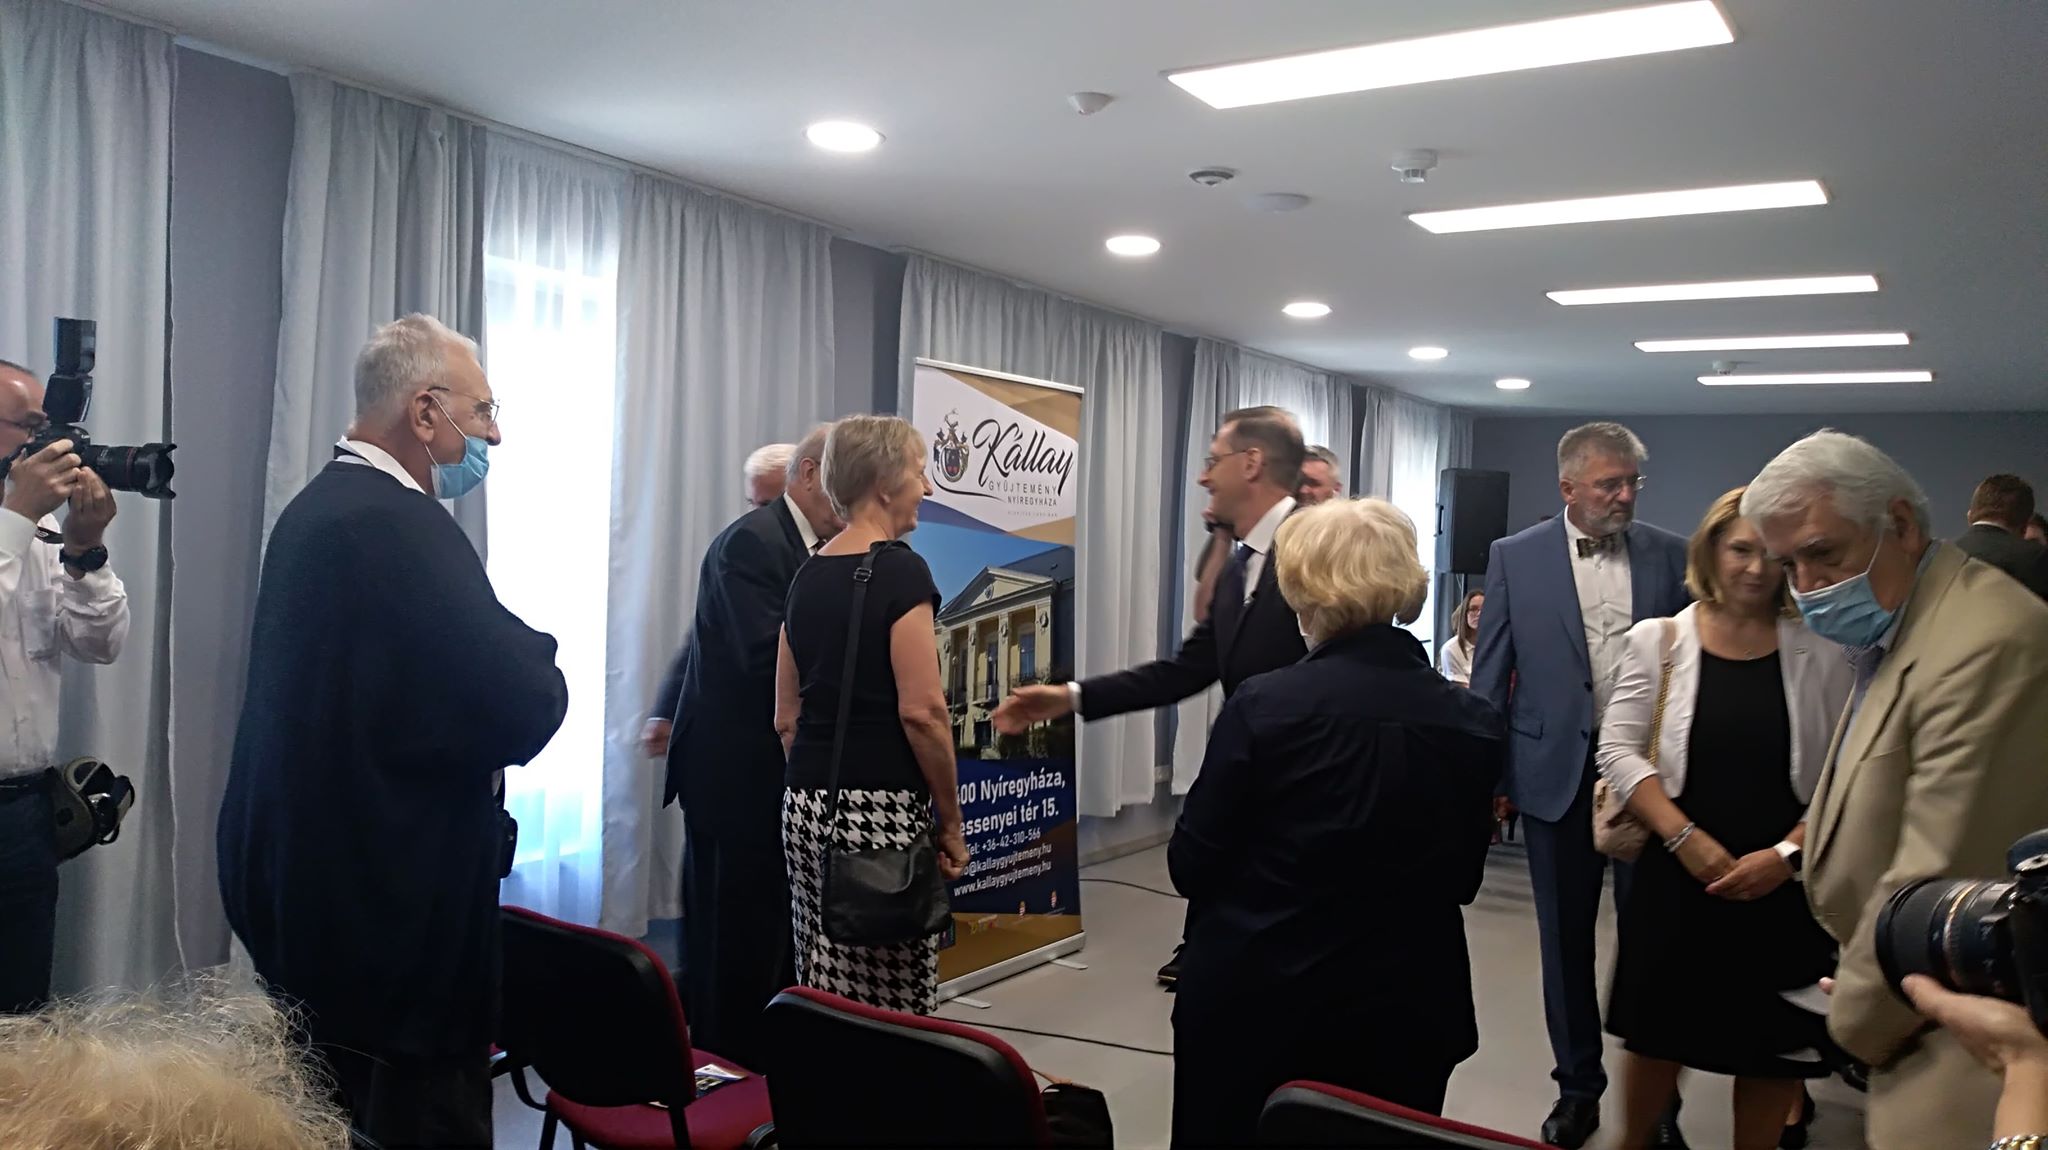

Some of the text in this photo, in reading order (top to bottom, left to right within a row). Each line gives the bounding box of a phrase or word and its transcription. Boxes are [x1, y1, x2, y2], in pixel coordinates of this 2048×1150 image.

[972, 419, 1073, 496] Kállay
[1007, 496, 1057, 507] NYÍREGYHÁZA
[980, 767, 1066, 804] Nyíregyháza,
[959, 797, 1060, 836] essenyei tér 15.
[960, 843, 1052, 877] o@kallaygyujtemeny.hu
[954, 861, 1051, 896] www.kallaygyujtemeny.hu
